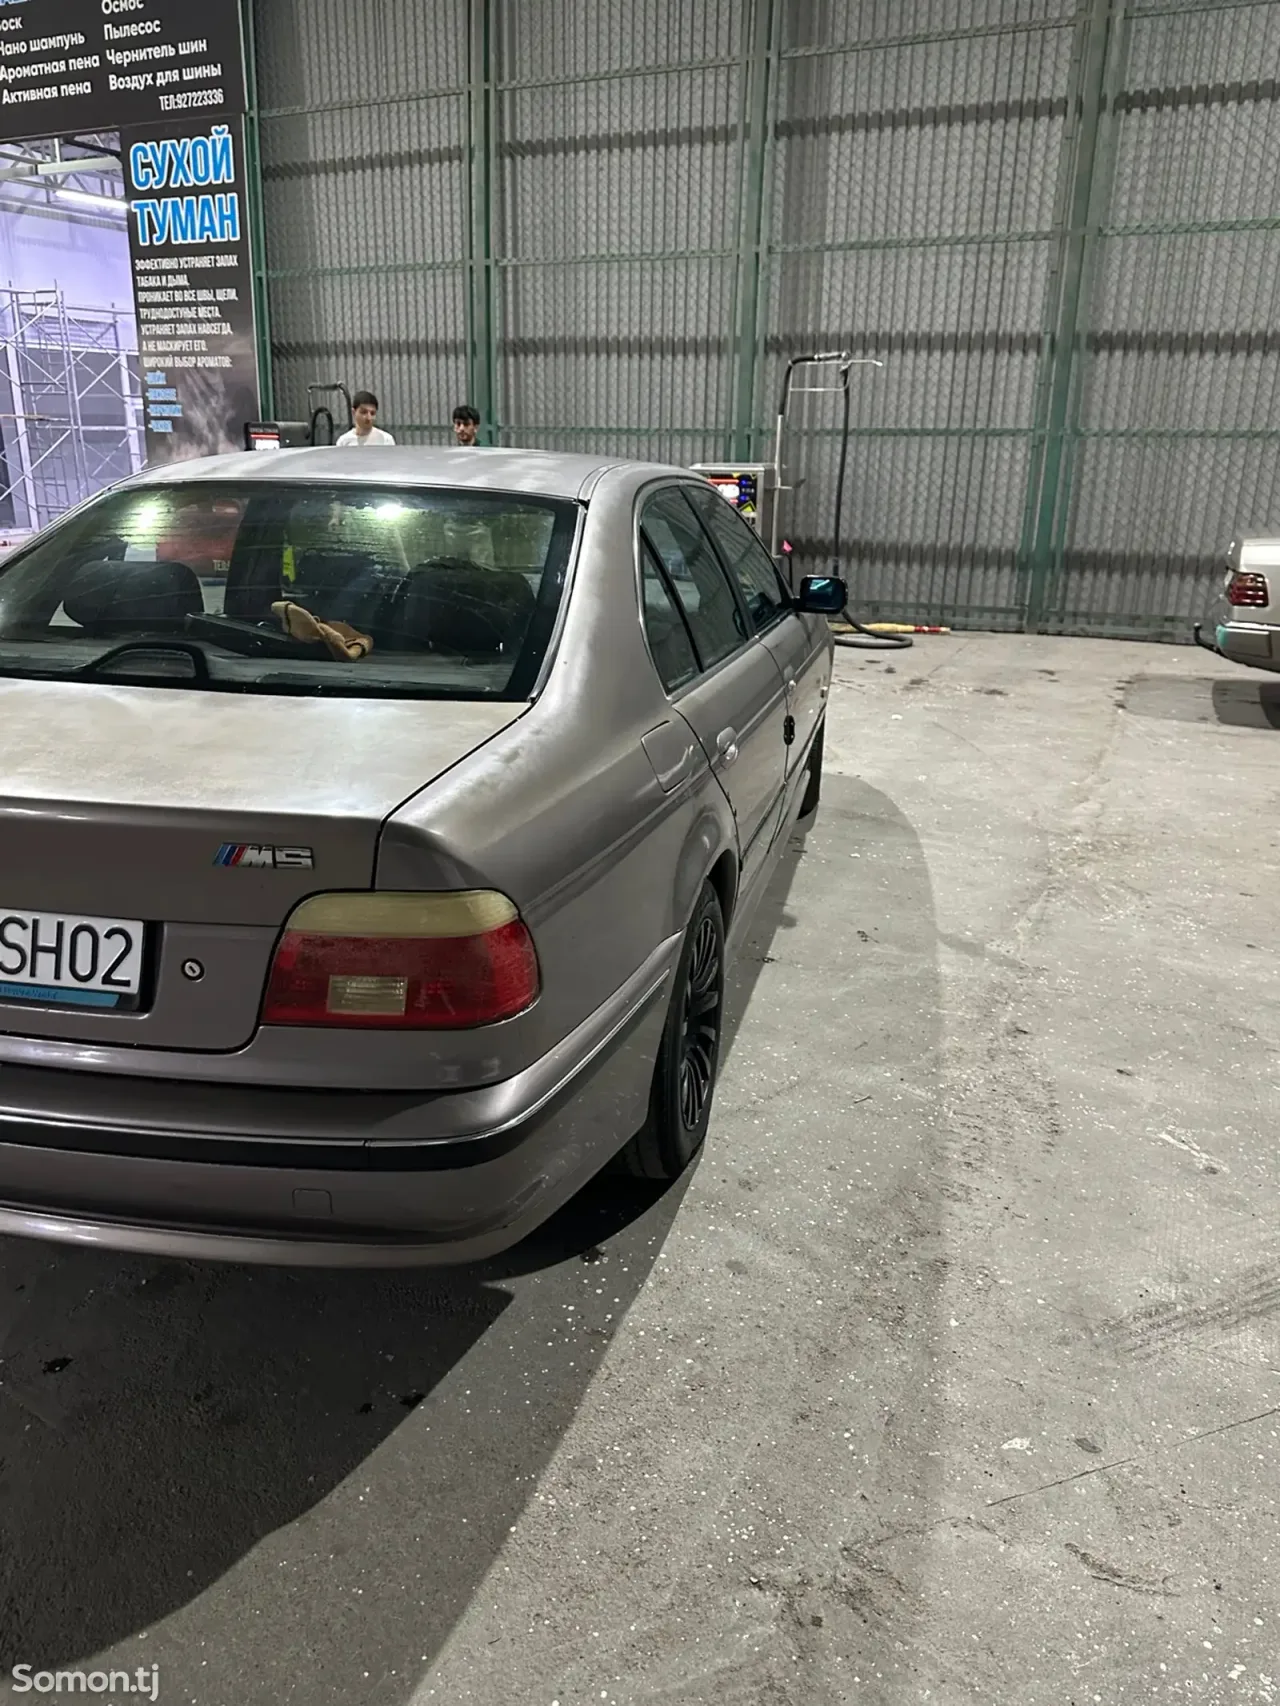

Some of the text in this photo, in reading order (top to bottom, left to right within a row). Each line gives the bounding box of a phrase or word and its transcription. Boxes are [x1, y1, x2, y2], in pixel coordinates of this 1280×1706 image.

[101, 0, 145, 15] Осмос
[0, 17, 23, 31] оск
[103, 19, 161, 41] Пылесос
[29, 32, 86, 51] шампунь
[106, 39, 207, 67] Чернитель шин
[0, 54, 100, 83] Ароматная пена
[108, 63, 222, 91] Воздух для шины
[2, 80, 92, 105] Активная пена
[130, 124, 235, 190] СУХОЙ
[131, 192, 241, 246] ТУМАН
[136, 275, 161, 287] ТАБАКА
